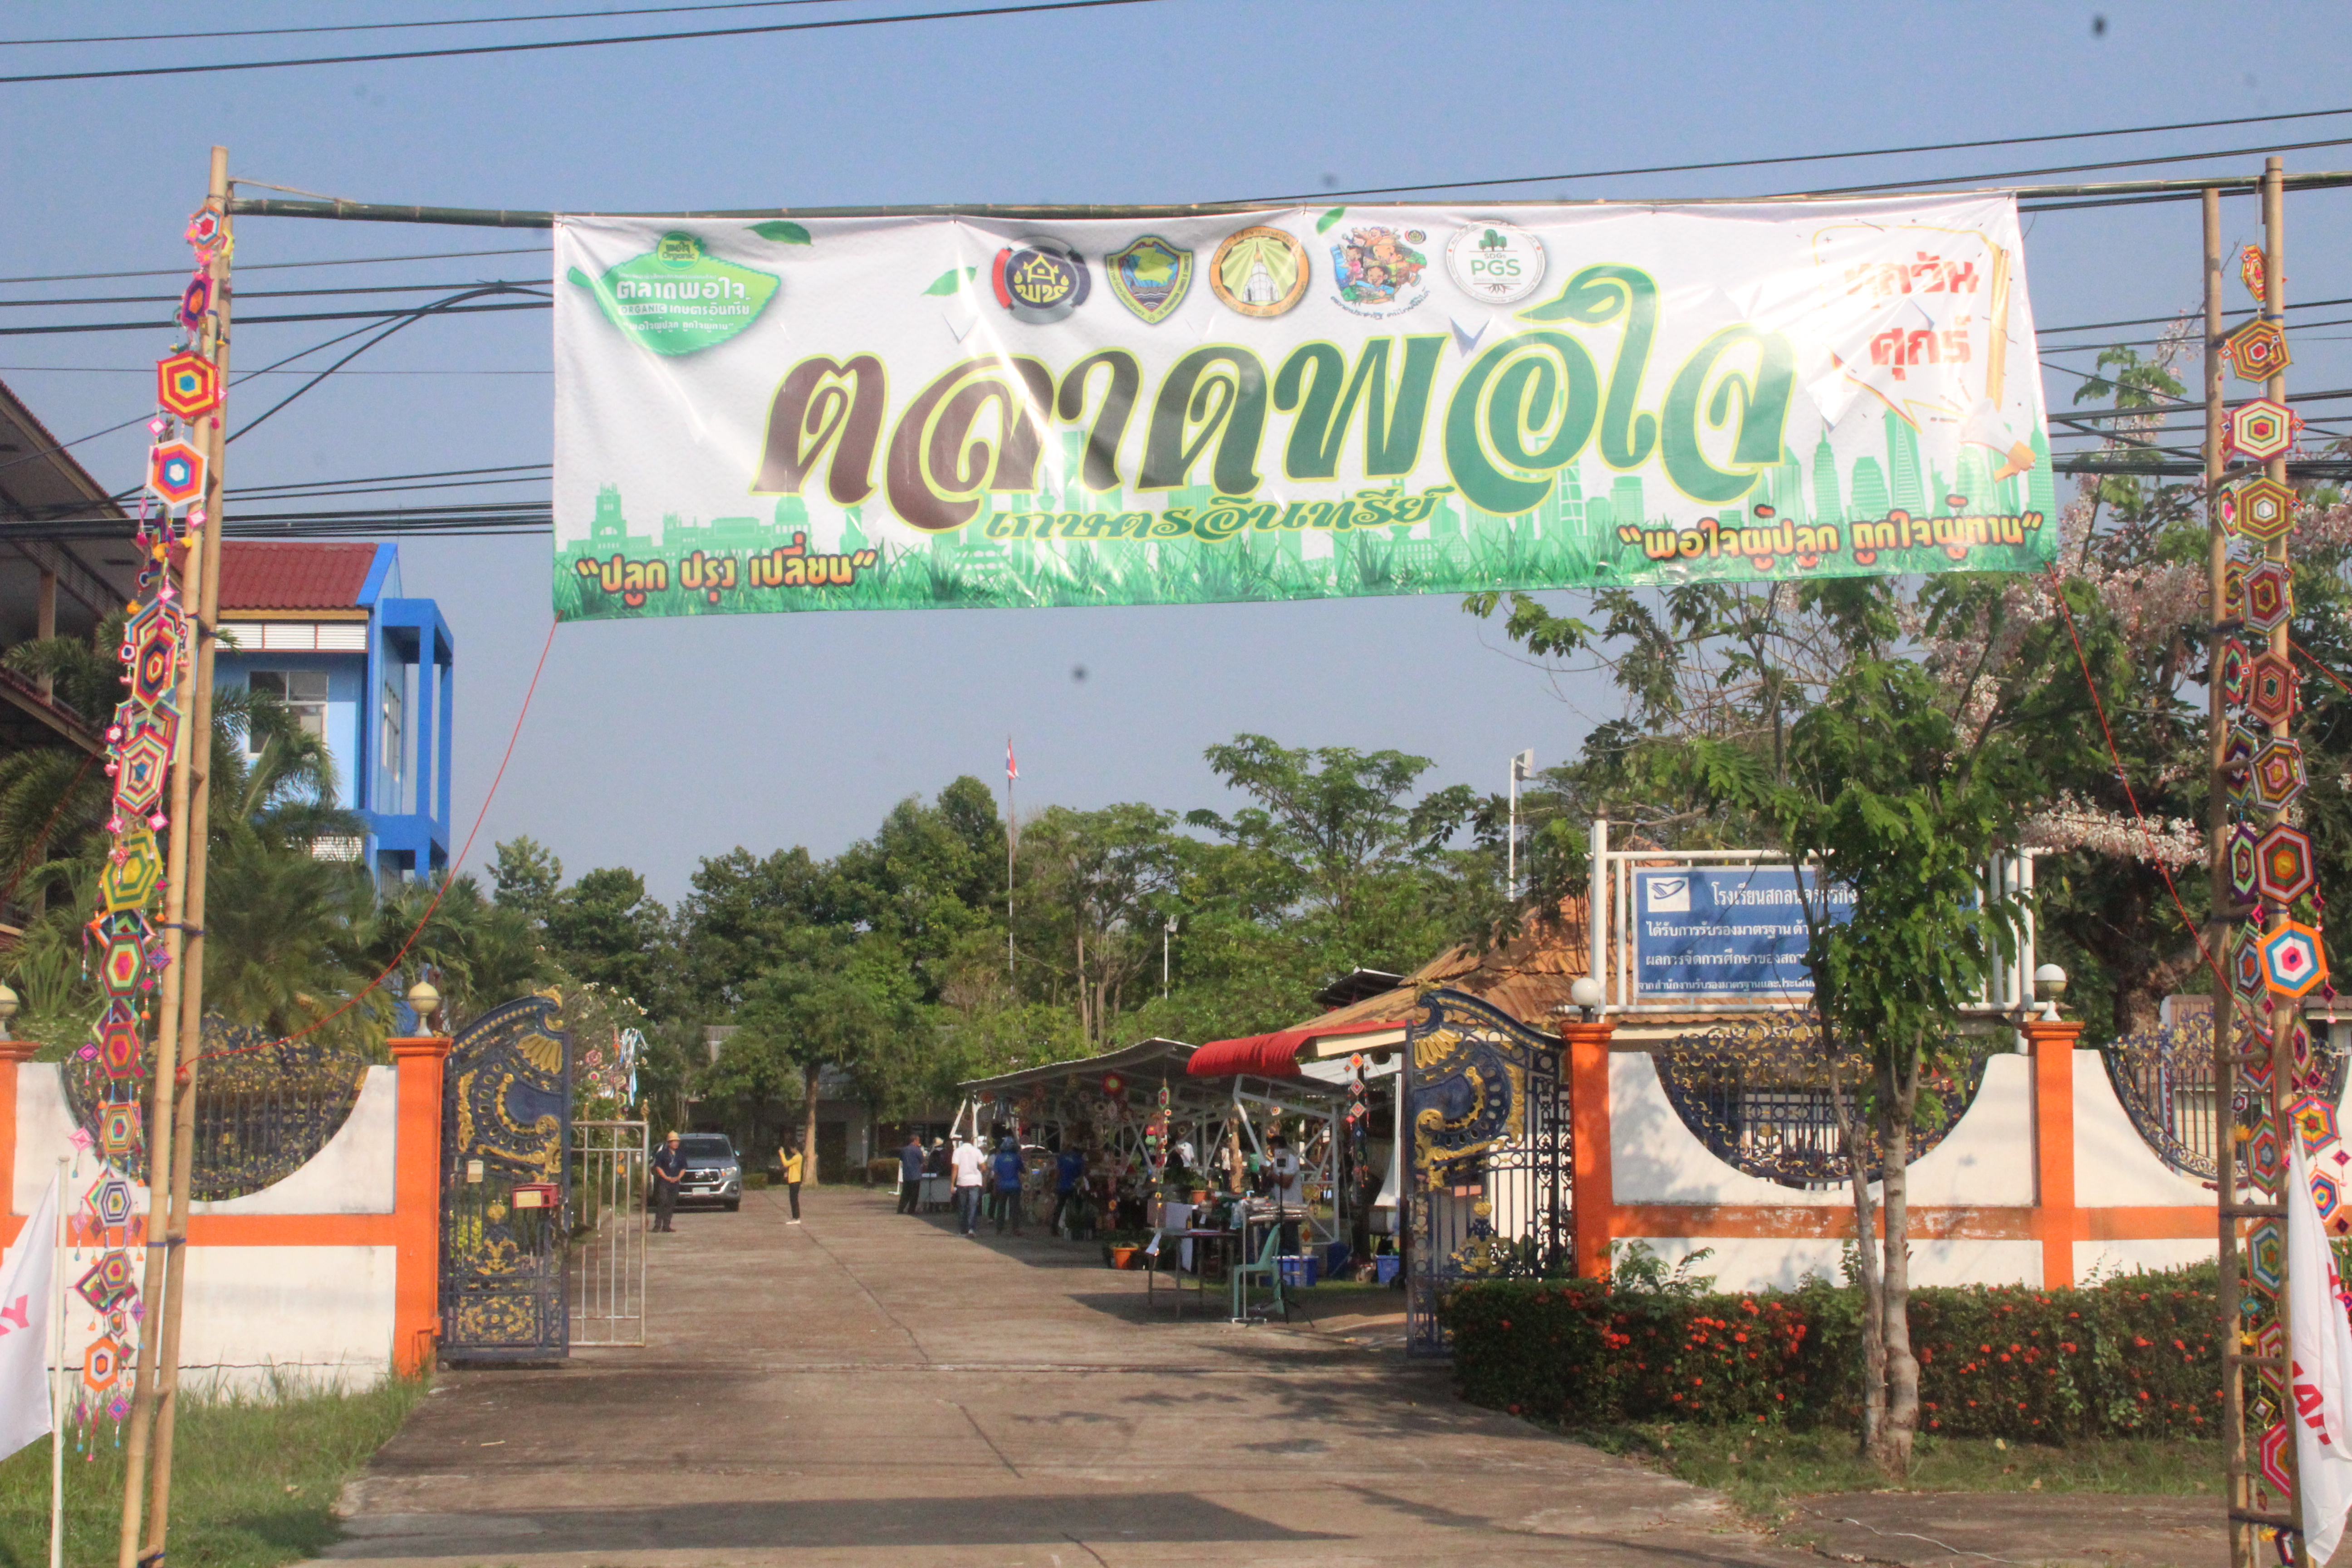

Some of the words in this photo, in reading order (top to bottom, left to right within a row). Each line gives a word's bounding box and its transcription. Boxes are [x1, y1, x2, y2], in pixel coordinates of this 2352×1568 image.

[662, 252, 695, 261] Organic
[1470, 259, 1521, 276] PGS
[617, 277, 745, 300] ตลาดพอใจ
[621, 305, 665, 315] ORGANIC
[669, 297, 751, 315] เกษตรอินทรีย์
[751, 264, 1794, 532] ตลาดพอใจ
[984, 485, 1455, 542] เกษตรอินทรีย์
[678, 550, 738, 604] ปรุง
[748, 531, 878, 589] เปลี่ยน”
[1646, 921, 1791, 939] ได้รับการรับรองมาตรฐาน
